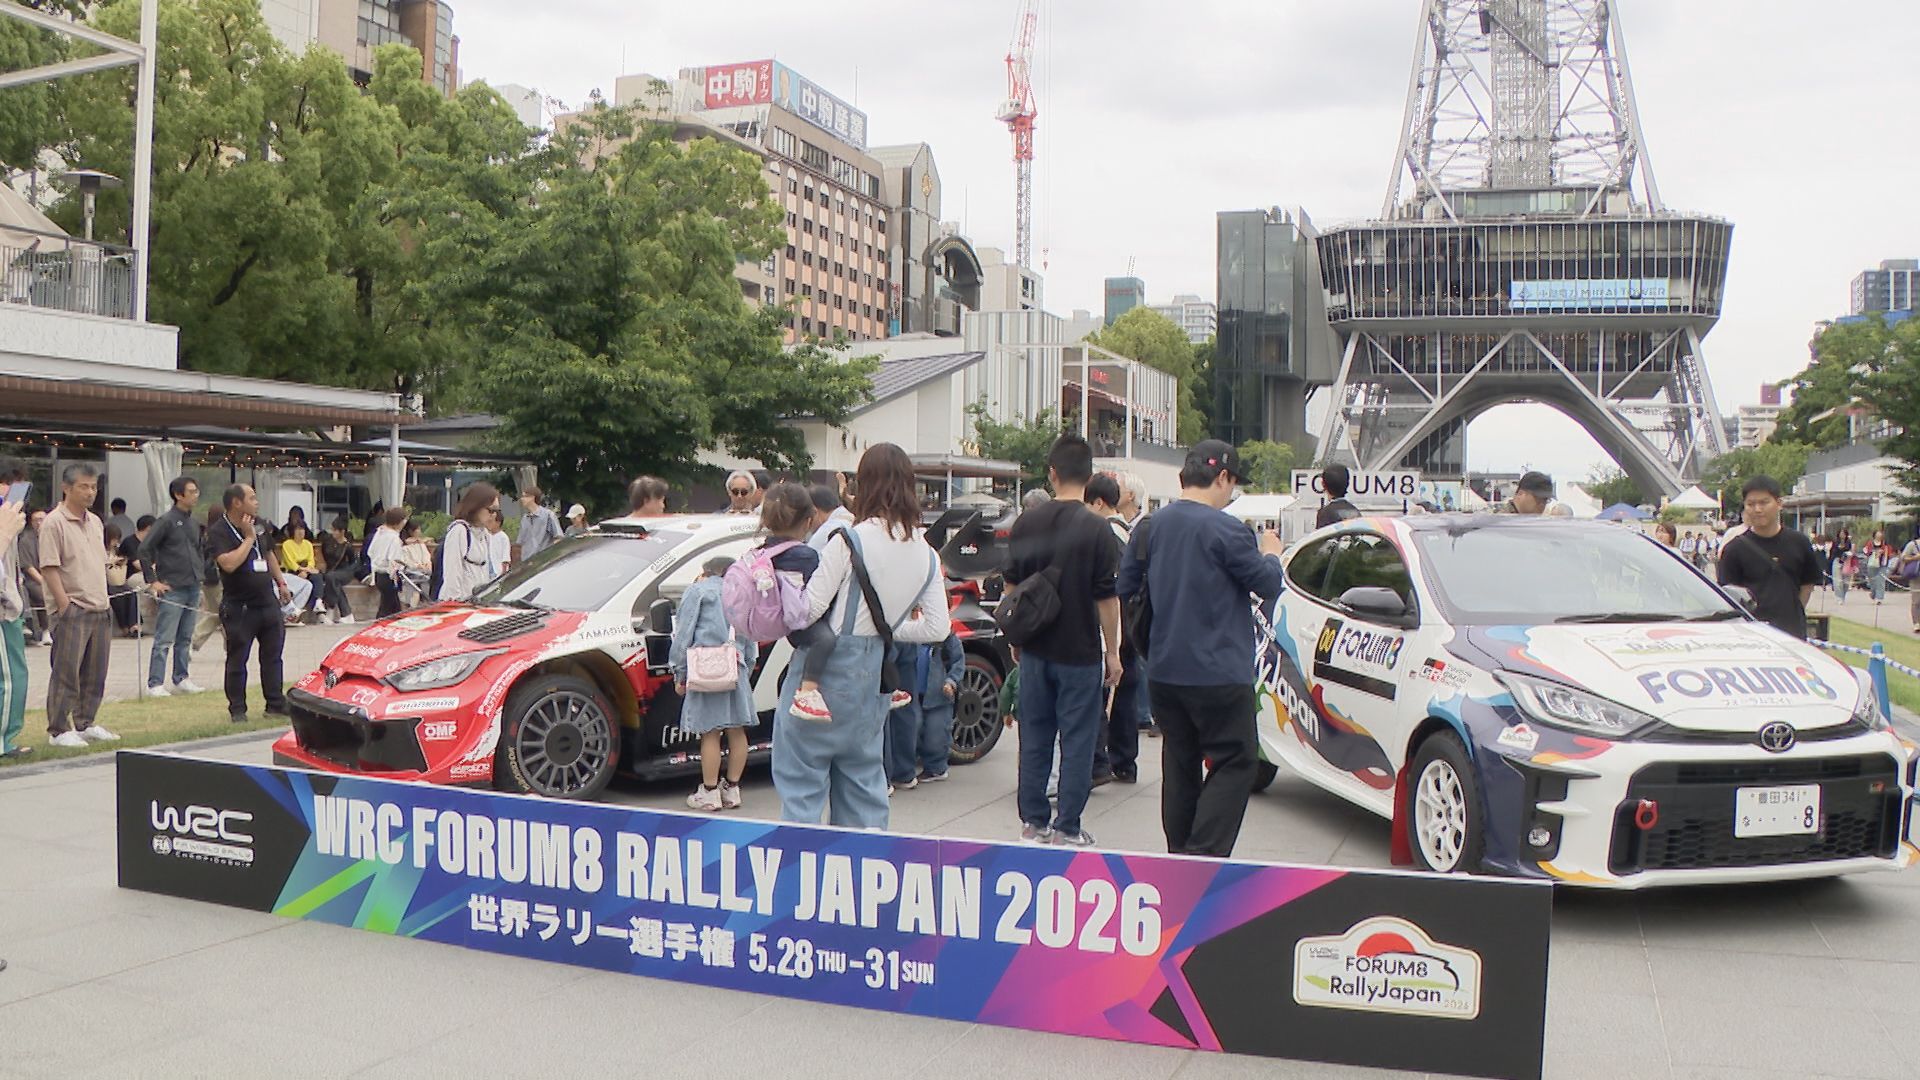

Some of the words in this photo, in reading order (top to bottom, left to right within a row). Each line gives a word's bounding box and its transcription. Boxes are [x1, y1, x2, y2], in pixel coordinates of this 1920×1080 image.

[709, 68, 757, 102] 中駒
[1295, 474, 1415, 495] FOUM8
[1337, 627, 1405, 671] FORUM8
[1636, 666, 1837, 704] FORUM8
[425, 724, 457, 737] OMP
[151, 799, 253, 844] WRC
[314, 794, 404, 865] WRC
[412, 806, 604, 893] FORUM8
[617, 831, 783, 916] RALLY
[794, 850, 981, 940] JAPAN
[994, 871, 1162, 956] 2026
[468, 893, 736, 968] 世界ラリー選手権
[1345, 956, 1428, 978] FORUM8
[1330, 975, 1441, 1003] RallyJapan
